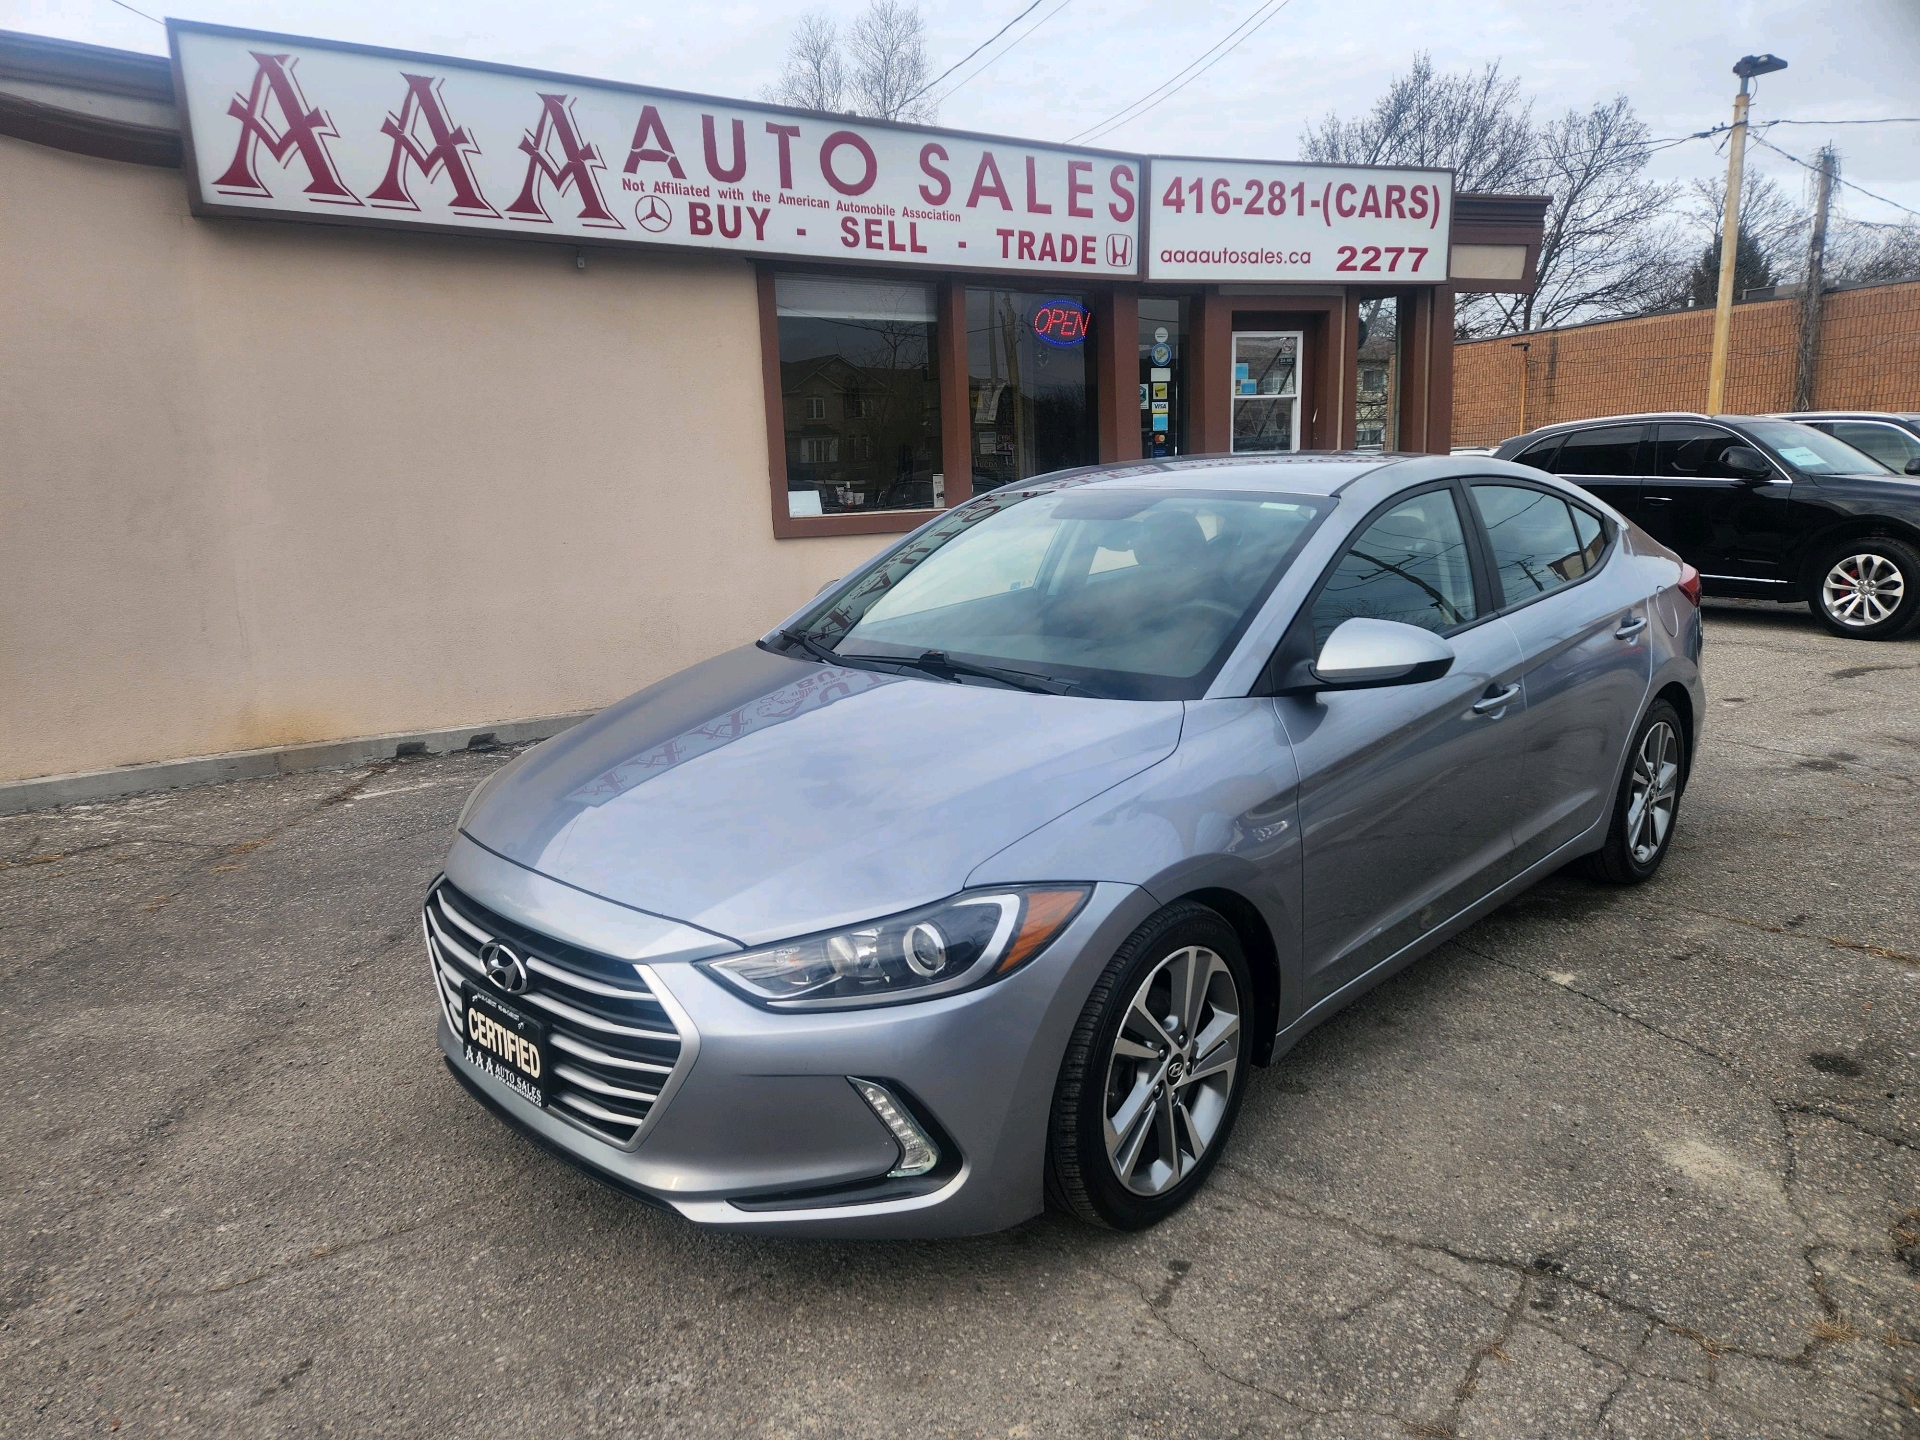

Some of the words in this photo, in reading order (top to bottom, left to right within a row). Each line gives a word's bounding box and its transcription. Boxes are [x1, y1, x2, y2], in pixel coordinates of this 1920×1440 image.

[623, 105, 877, 196] AUTO
[919, 142, 1135, 222] SALES
[622, 177, 646, 193] Not
[652, 180, 711, 198] Affiliated
[717, 185, 745, 202] with
[752, 188, 771, 203] the
[778, 192, 830, 209] American
[836, 200, 896, 218] Automobile
[902, 205, 961, 222] Association
[1162, 175, 1441, 229] 416-281-(CARS)
[689, 202, 772, 241] BUY
[840, 216, 928, 254] SELL
[996, 228, 1097, 265] TRADE
[1160, 247, 1311, 264] aaaautosales.ca
[1336, 245, 1429, 272] 2277
[1034, 308, 1091, 336] OPEN
[468, 1007, 541, 1079] CERTIFIED
[495, 1063, 515, 1084] AUTO
[516, 1077, 542, 1102] SALES
